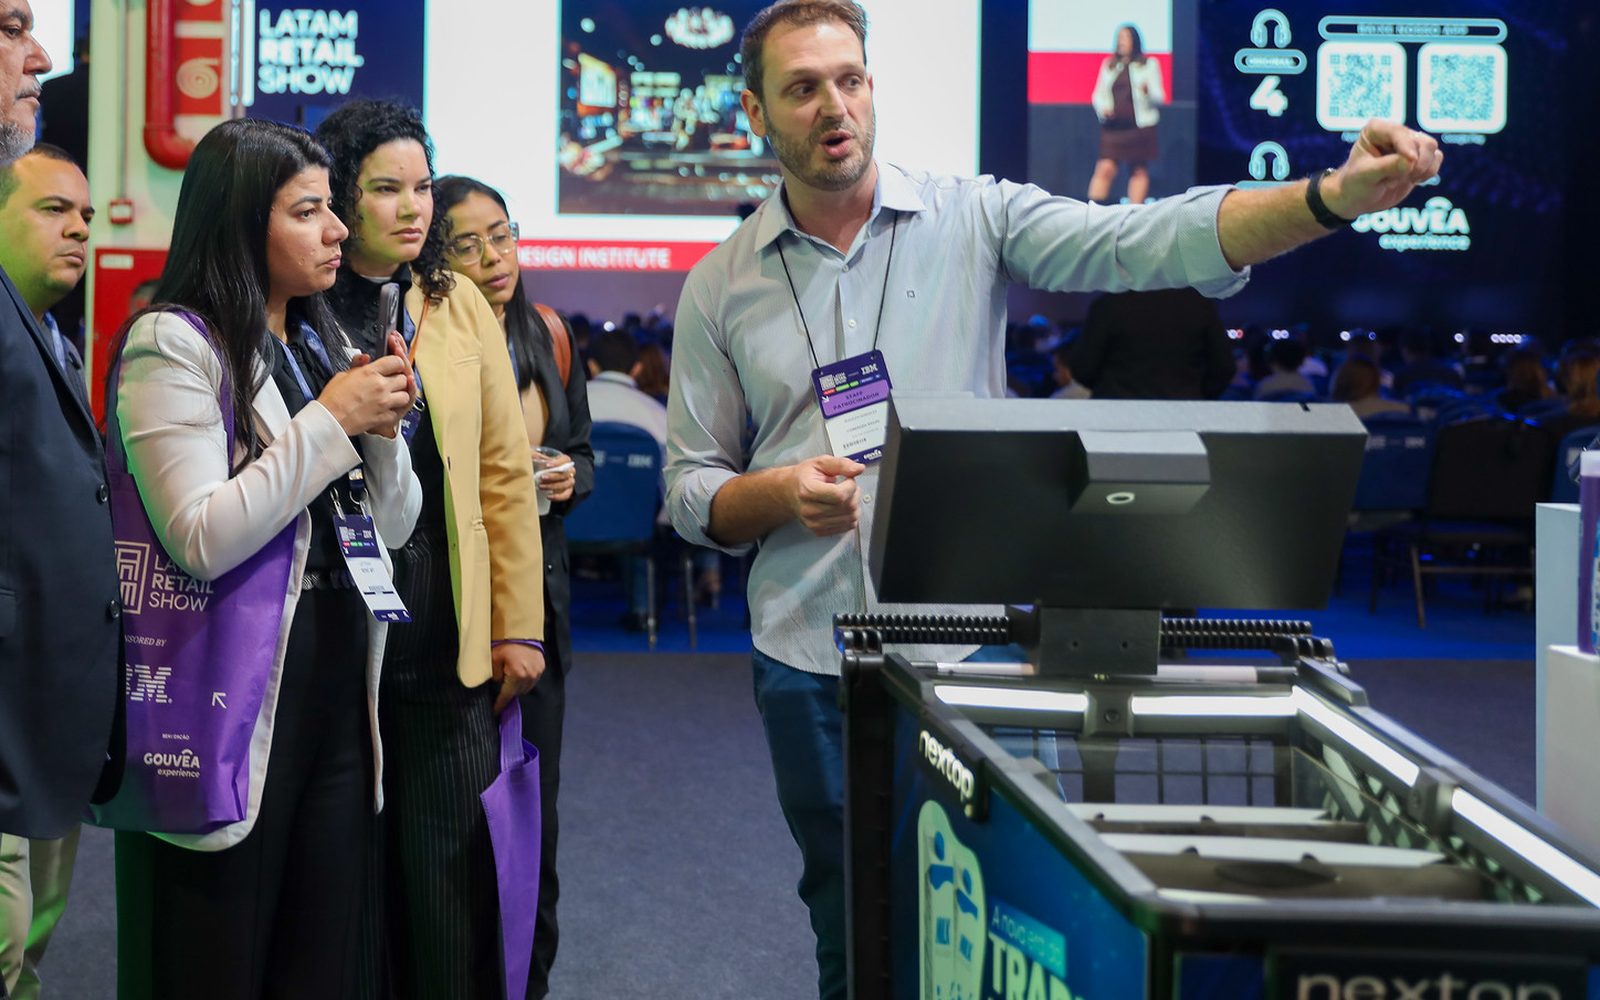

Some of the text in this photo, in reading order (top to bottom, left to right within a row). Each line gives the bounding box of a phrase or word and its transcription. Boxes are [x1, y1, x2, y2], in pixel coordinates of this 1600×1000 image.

[259, 9, 358, 40] LATAM
[259, 38, 365, 67] RETAIL
[258, 65, 355, 94] SHOW
[1250, 75, 1288, 116] 4
[517, 245, 672, 269] ESIGN INSTITUTE
[861, 364, 878, 375] IBM
[627, 453, 653, 468] IBM
[151, 572, 214, 594] RETAIL
[148, 591, 209, 612] SHOW
[155, 638, 168, 648] BY
[143, 748, 200, 769] GOUVÊA
[919, 730, 975, 803] nextop
[157, 768, 200, 778] experience
